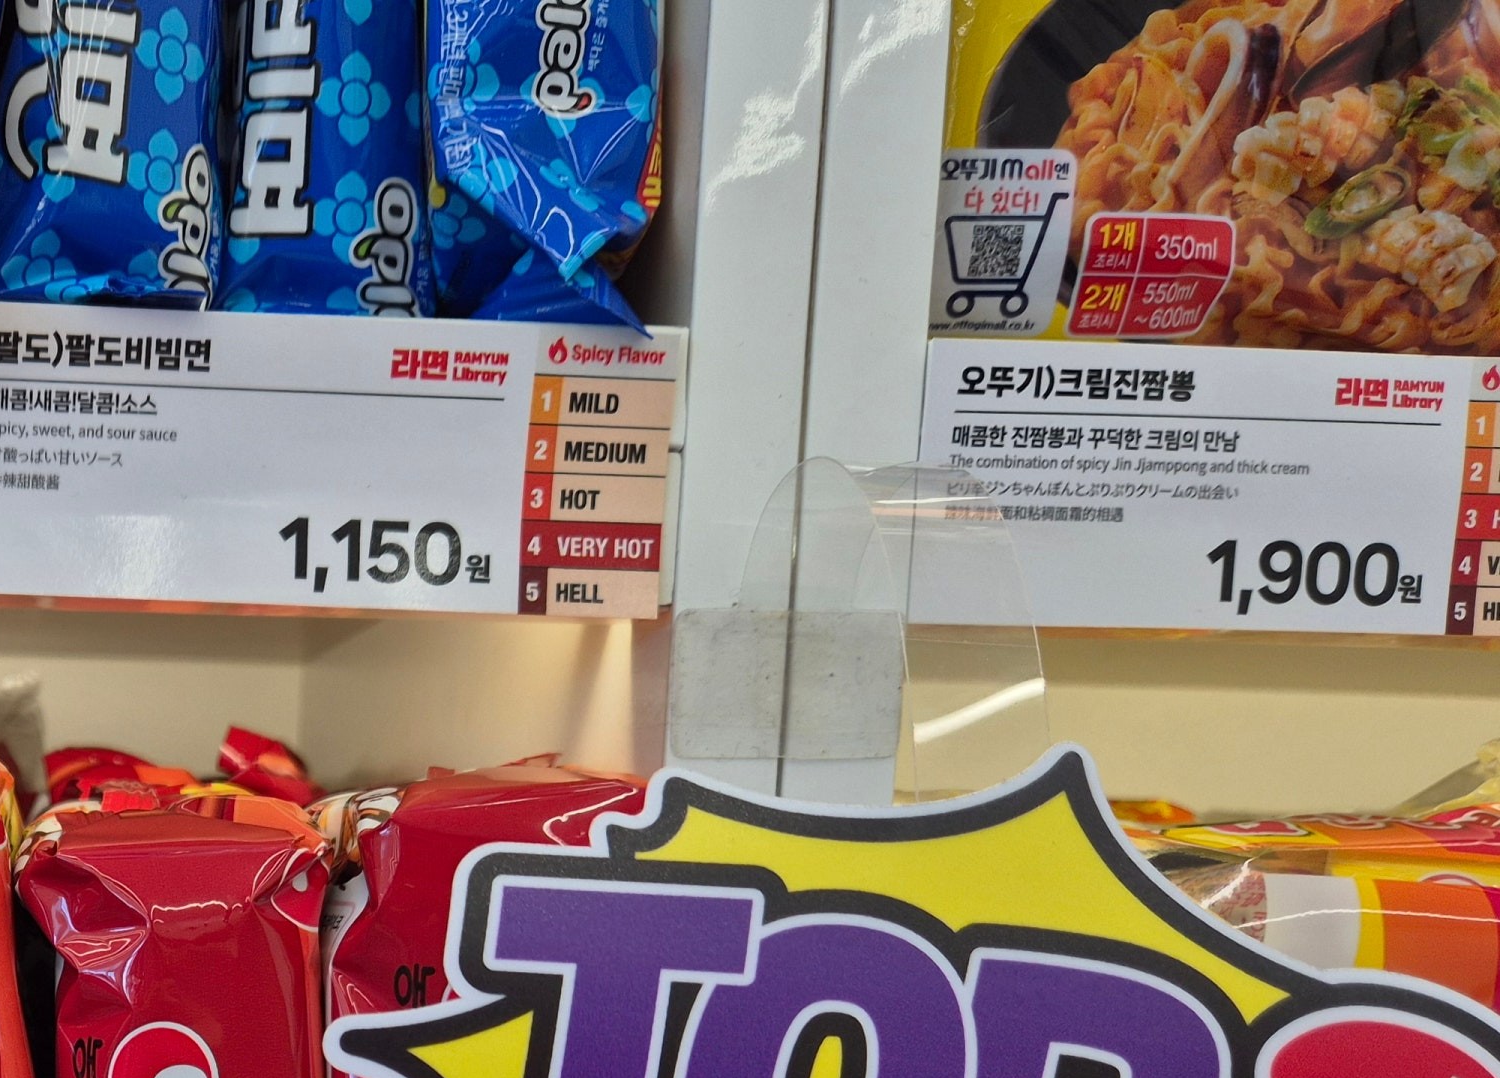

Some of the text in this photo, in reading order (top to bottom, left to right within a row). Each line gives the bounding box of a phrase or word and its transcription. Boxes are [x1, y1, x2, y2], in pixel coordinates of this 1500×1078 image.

[964, 186, 1040, 215] 다 있다!
[159, 145, 212, 309] ldo
[1099, 222, 1136, 250] 1개
[353, 178, 417, 316] ldo
[1154, 235, 1217, 261] 350ml
[1092, 252, 1132, 269] 조리시
[1081, 283, 1127, 311] 2개
[1141, 282, 1197, 305] 550ml
[1077, 313, 1116, 330] 조리시
[391, 348, 449, 382] 라면
[454, 351, 509, 367] RAMYUN
[571, 344, 667, 369] Spicy Flavor
[452, 366, 507, 387] Library
[957, 366, 1196, 403] 오뚜기)크림진짬뽕
[1393, 380, 1445, 394] RAMYUN
[540, 391, 620, 415] 1 MILD
[1335, 377, 1388, 408] 라면
[1392, 393, 1443, 411] Library
[32, 423, 75, 440] sweet,
[78, 424, 104, 440] and
[107, 428, 137, 441] sour
[139, 429, 178, 442] sauce
[1474, 416, 1486, 436] 1
[951, 425, 1240, 453] 매콤한 진짬뽕과 꾸덕한 크림의 만남
[534, 440, 647, 465] 2 MEDIUM
[950, 454, 1310, 477] The combination of spicy Jin Jjamppong and thick cream
[1469, 463, 1483, 482] 2
[530, 487, 601, 511] 3 HOT
[1464, 510, 1478, 529] 3
[526, 534, 654, 560] 4 VERY HOT
[1458, 556, 1472, 575] 4
[526, 581, 604, 605] 5 HELL
[1453, 601, 1467, 621] 5
[393, 964, 436, 1008] 농
